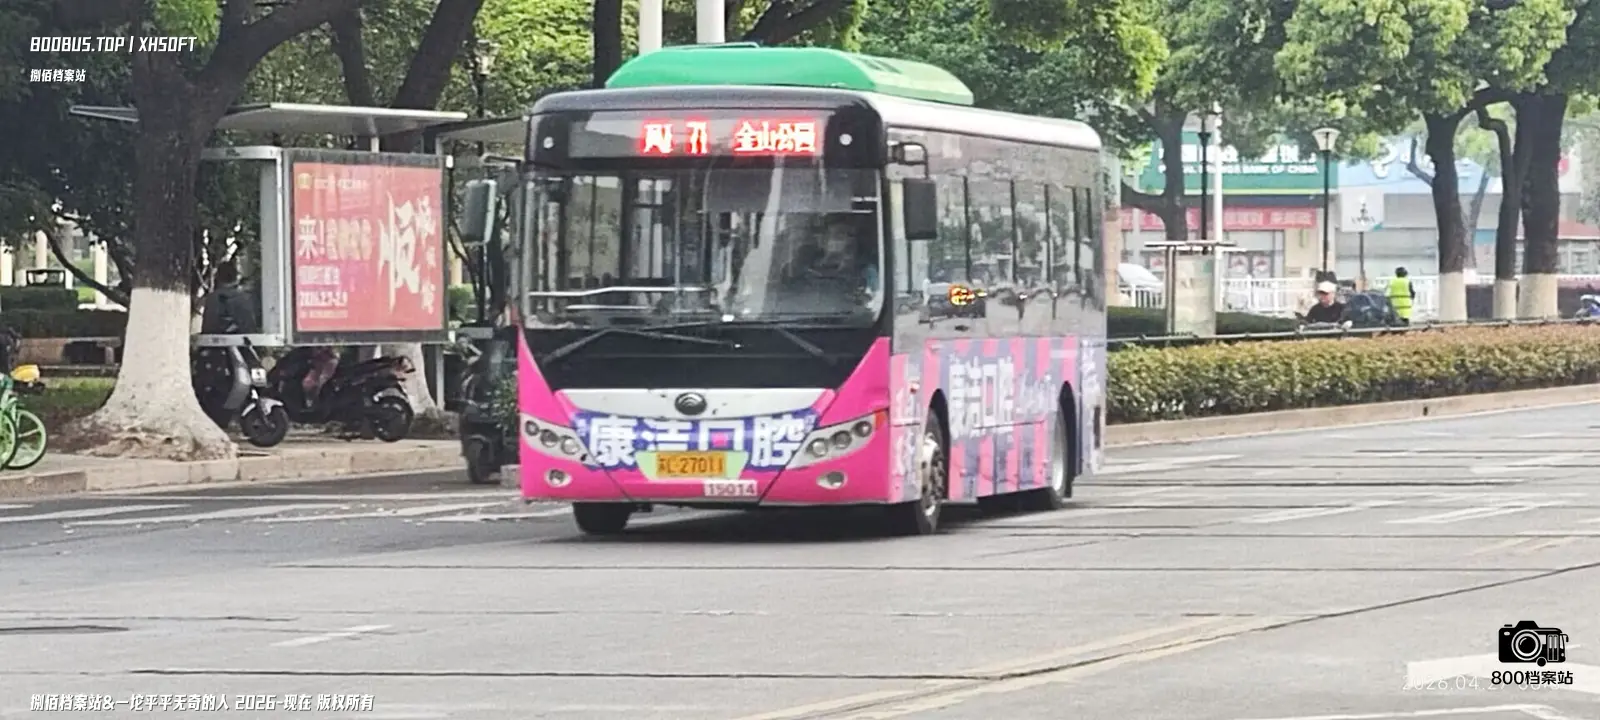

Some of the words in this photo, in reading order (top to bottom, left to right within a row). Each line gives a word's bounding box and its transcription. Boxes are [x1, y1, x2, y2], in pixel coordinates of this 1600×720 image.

[734, 120, 816, 152] 金山公园
[590, 415, 805, 467] 康洁口腔
